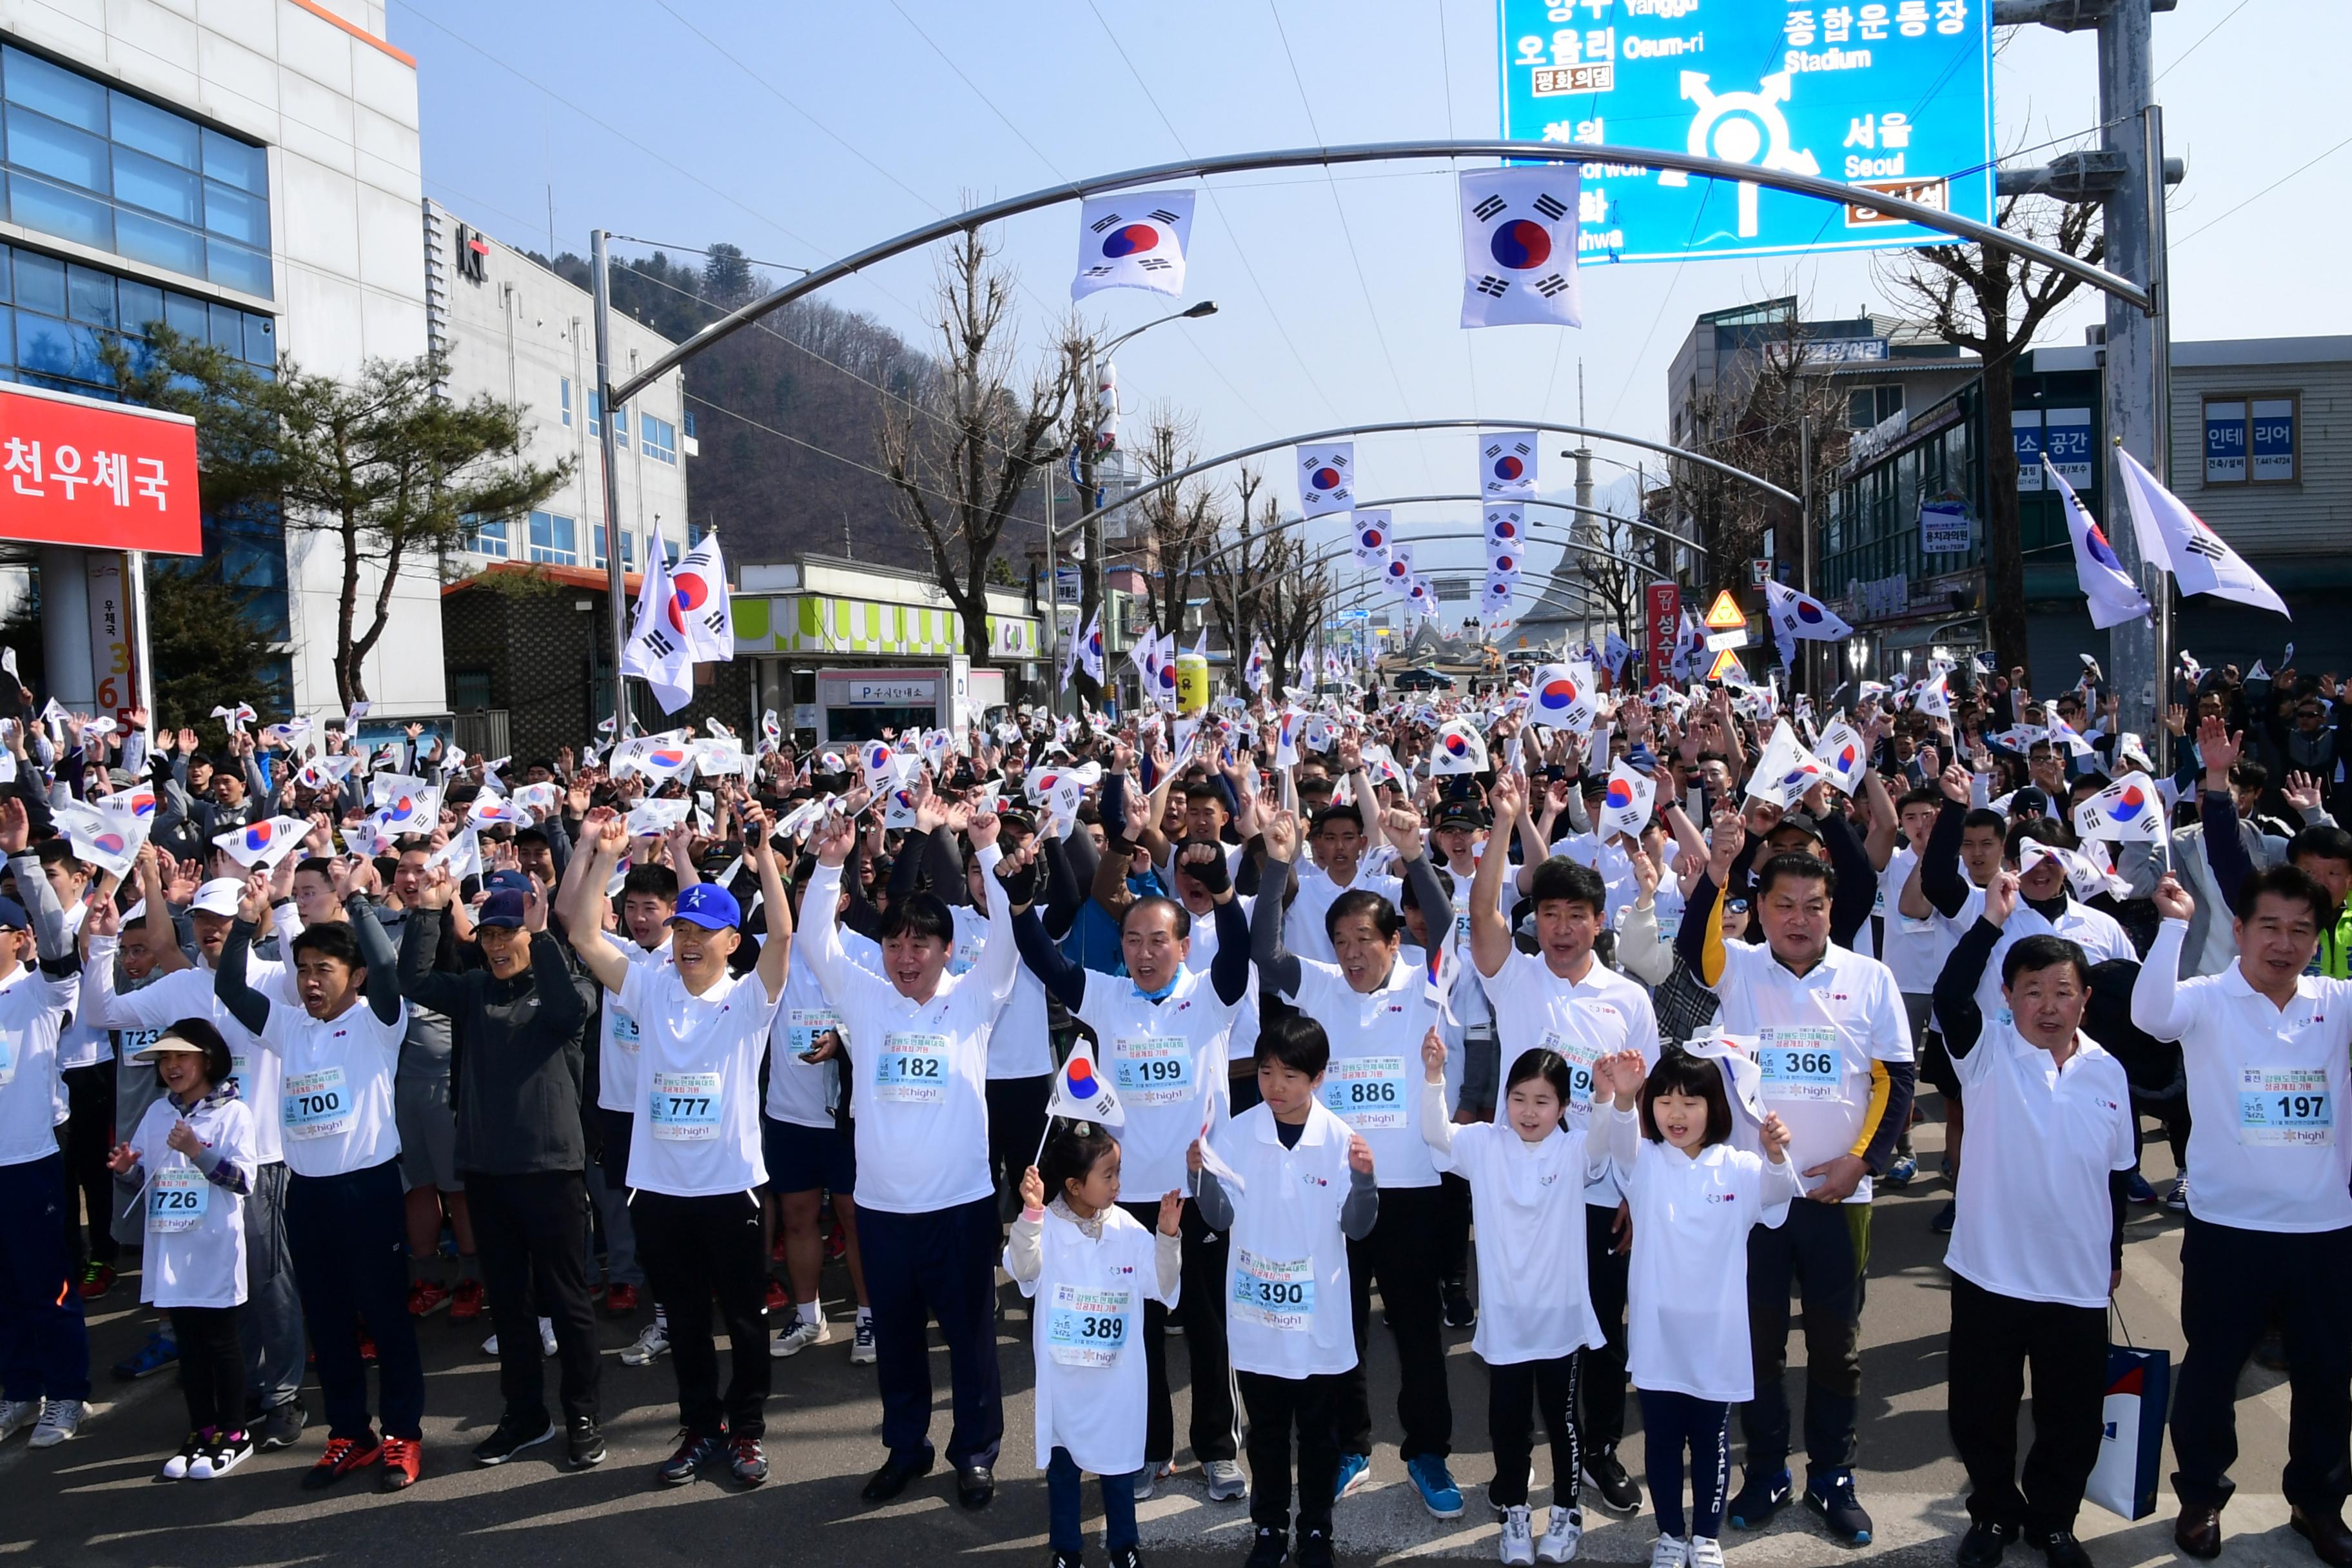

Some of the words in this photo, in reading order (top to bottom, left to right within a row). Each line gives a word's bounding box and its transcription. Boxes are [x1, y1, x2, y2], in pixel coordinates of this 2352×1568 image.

[1784, 0, 1967, 46] 종합운동장
[1515, 27, 1614, 65] 오음리
[1623, 32, 1703, 59] Oeum-ri
[1785, 48, 1871, 74] Stadium
[1537, 66, 1610, 92] 평화의댐
[1843, 113, 1912, 149] 서울
[1845, 152, 1904, 178] Seoul
[2050, 433, 2088, 455] 공간
[3, 436, 169, 511] 천우체국
[1925, 530, 1968, 543] 용치과의원
[104, 600, 116, 636] 우체국
[863, 687, 871, 698] P
[126, 1030, 159, 1046] 723
[897, 1057, 939, 1077] 182
[1139, 1060, 1181, 1081] 199
[1785, 1052, 1832, 1074] 366
[1351, 1082, 1395, 1103] 886
[299, 1092, 340, 1116] 700
[669, 1097, 710, 1116] 777
[2277, 1096, 2324, 1118] 197
[157, 1191, 197, 1210] 726
[1259, 1282, 1303, 1304] 390
[1081, 1316, 1122, 1339] 389
[1565, 1422, 1580, 1496] ATHLETIC
